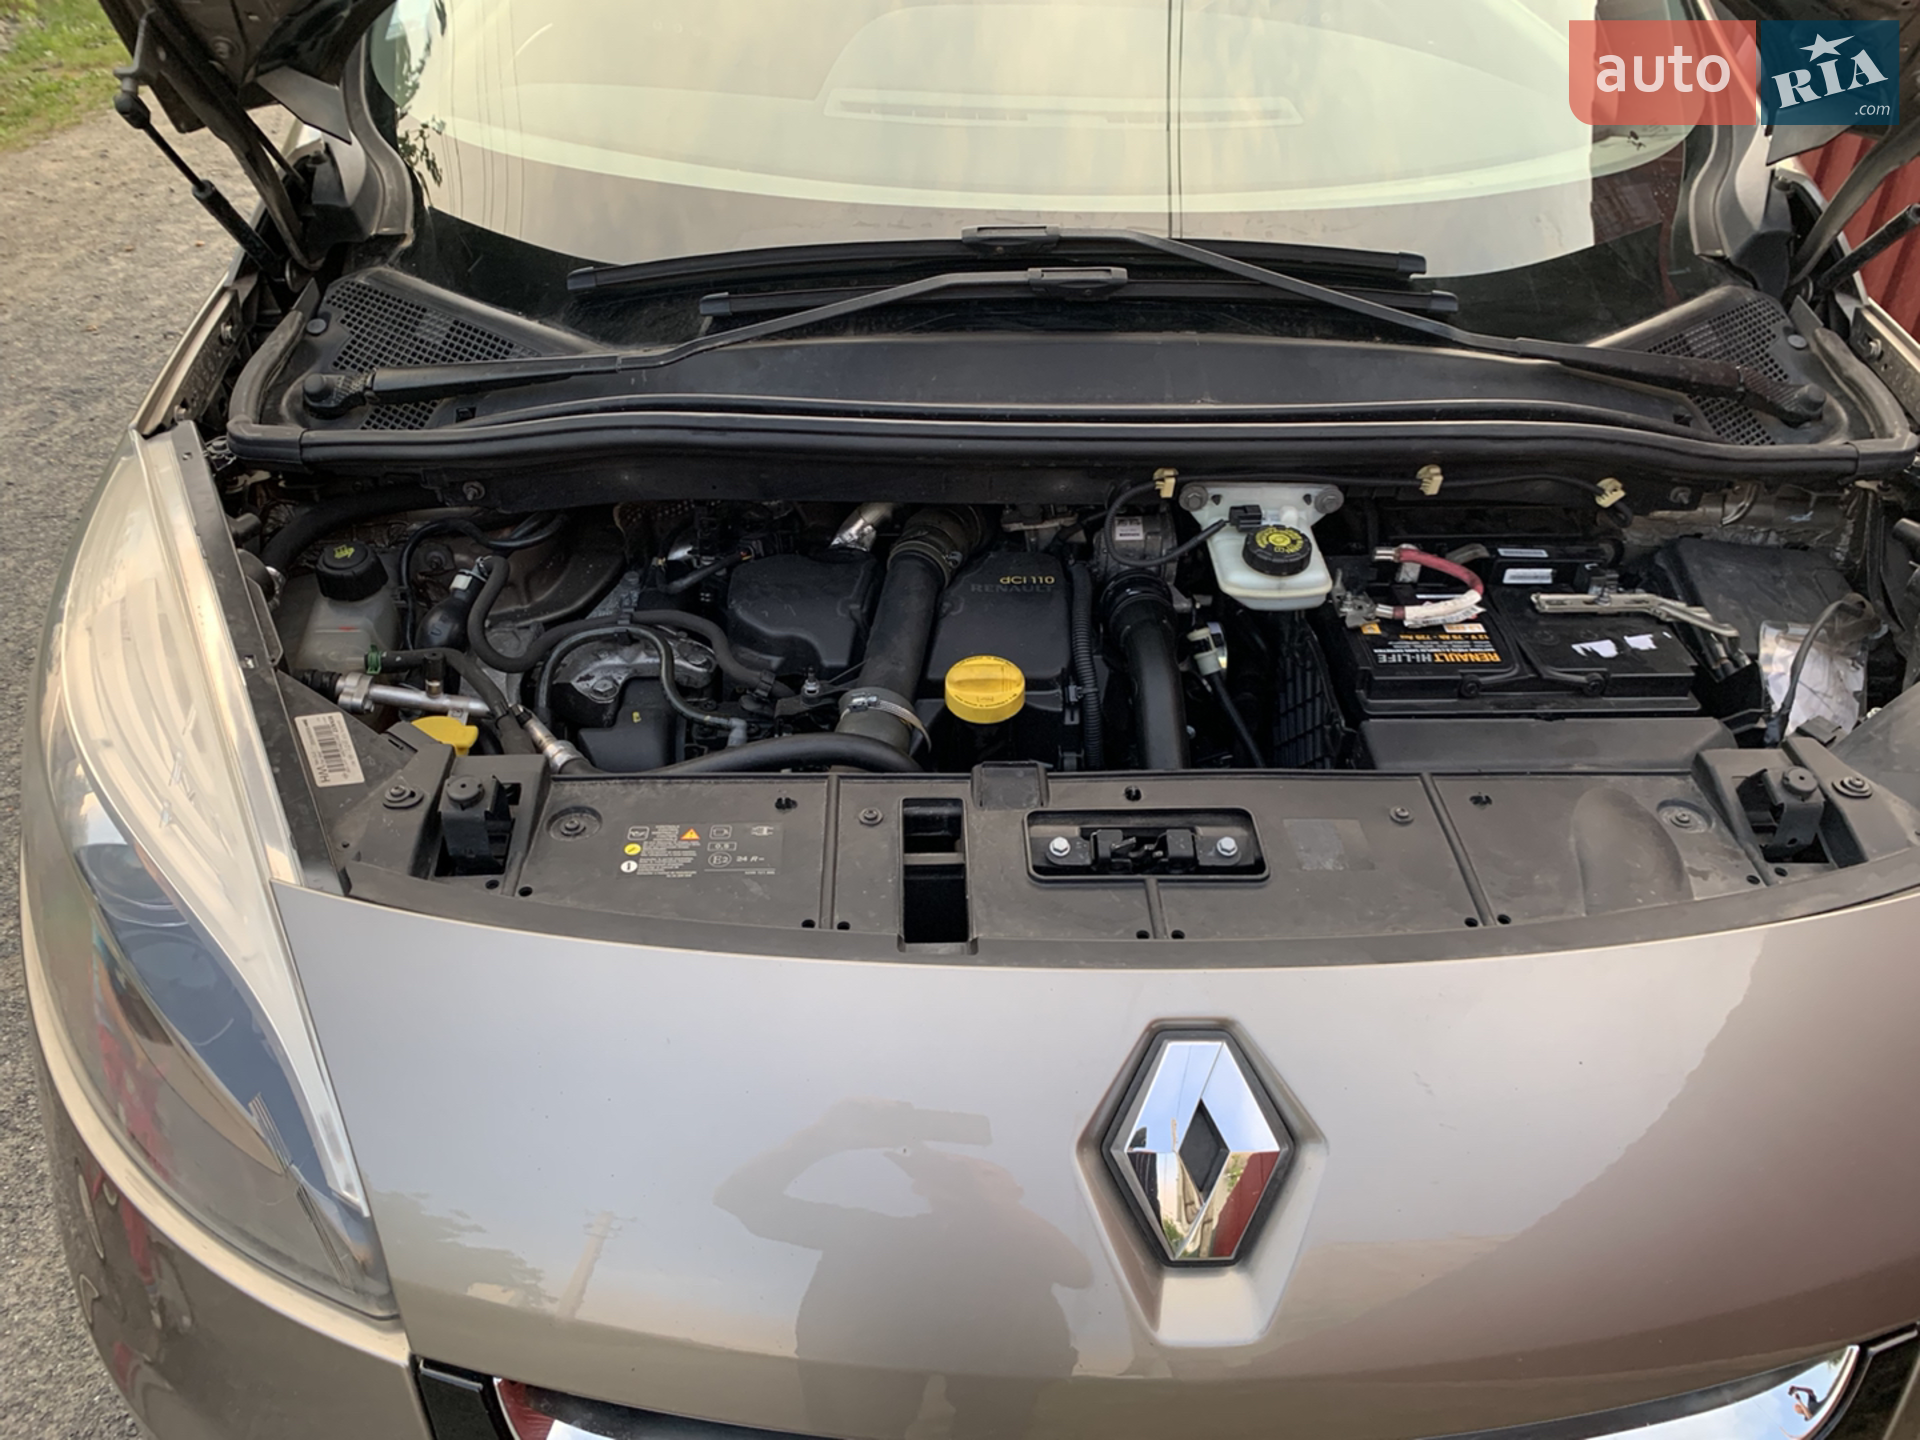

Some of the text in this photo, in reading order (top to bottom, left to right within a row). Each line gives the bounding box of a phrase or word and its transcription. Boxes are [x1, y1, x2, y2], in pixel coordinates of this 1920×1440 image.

[1030, 575, 1056, 585] 110
[970, 583, 1054, 593] RENAULT
[1434, 652, 1502, 662] RENAULT
